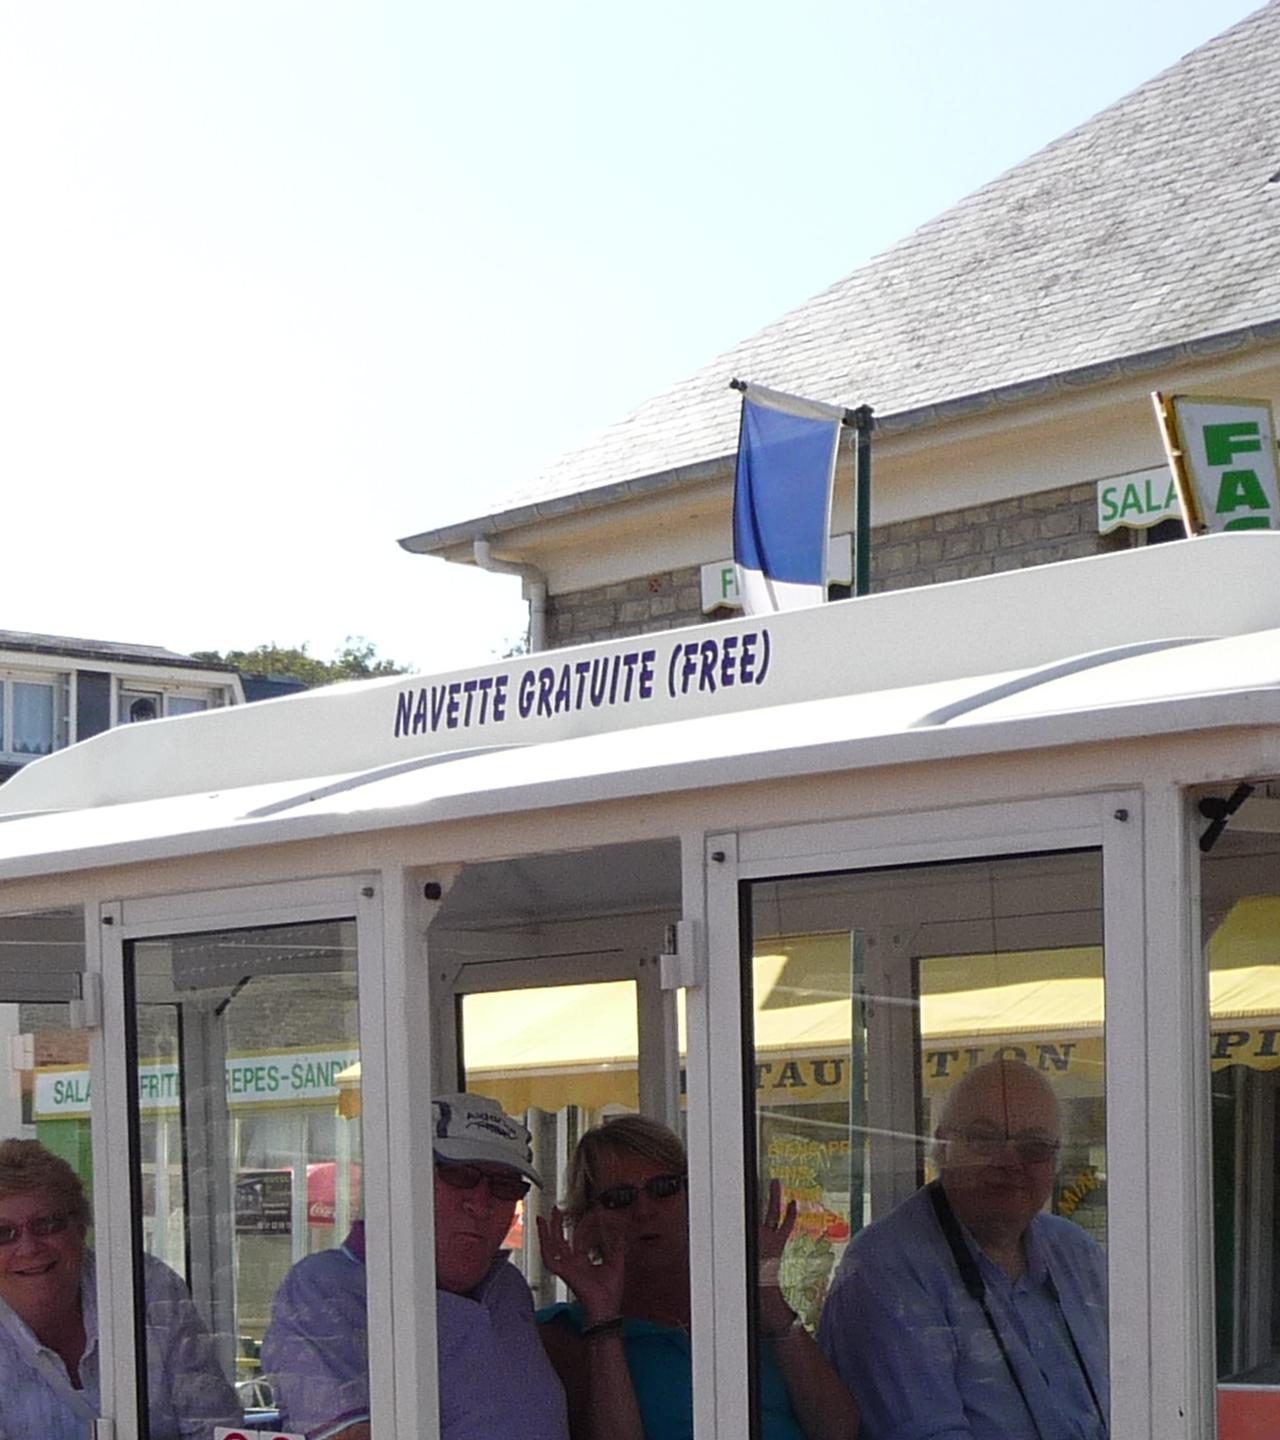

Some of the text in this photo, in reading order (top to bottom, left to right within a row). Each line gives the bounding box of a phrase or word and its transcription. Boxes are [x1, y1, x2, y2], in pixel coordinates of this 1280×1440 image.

[1202, 421, 1272, 531] FA
[393, 628, 772, 738] NAVETTE GRATUITE (FREE)
